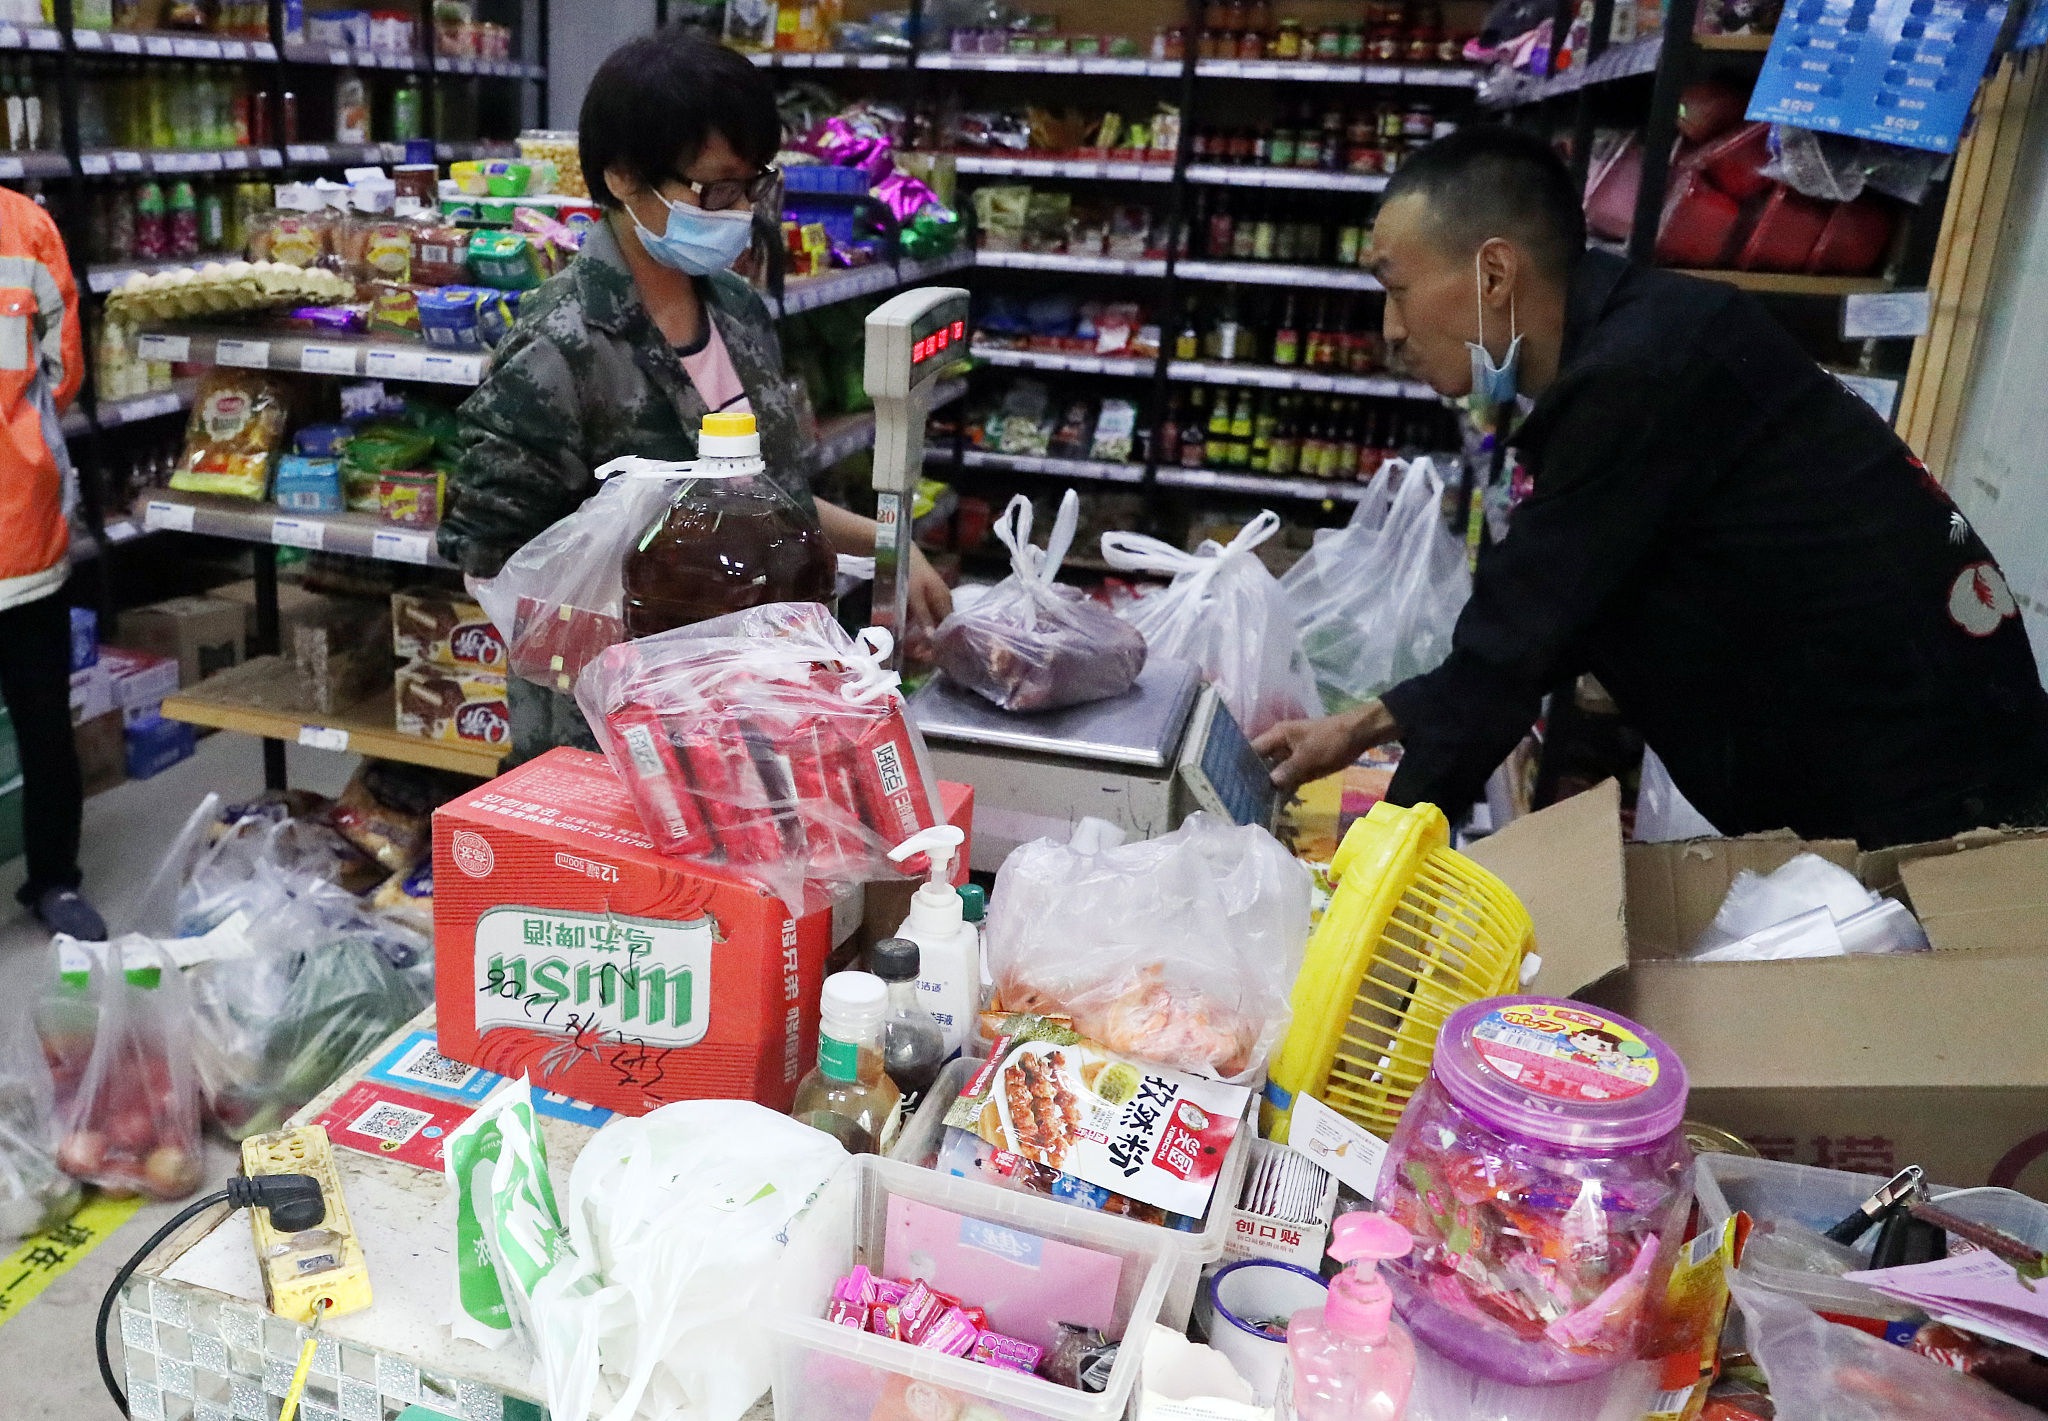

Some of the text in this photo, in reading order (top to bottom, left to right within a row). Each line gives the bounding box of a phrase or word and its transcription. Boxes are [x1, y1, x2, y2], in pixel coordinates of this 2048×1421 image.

[876, 745, 903, 795] 好吃点
[523, 919, 655, 958] 乌苏啤酒
[1108, 1074, 1179, 1178] 孜然粉
[1235, 1218, 1302, 1247] 创口贴
